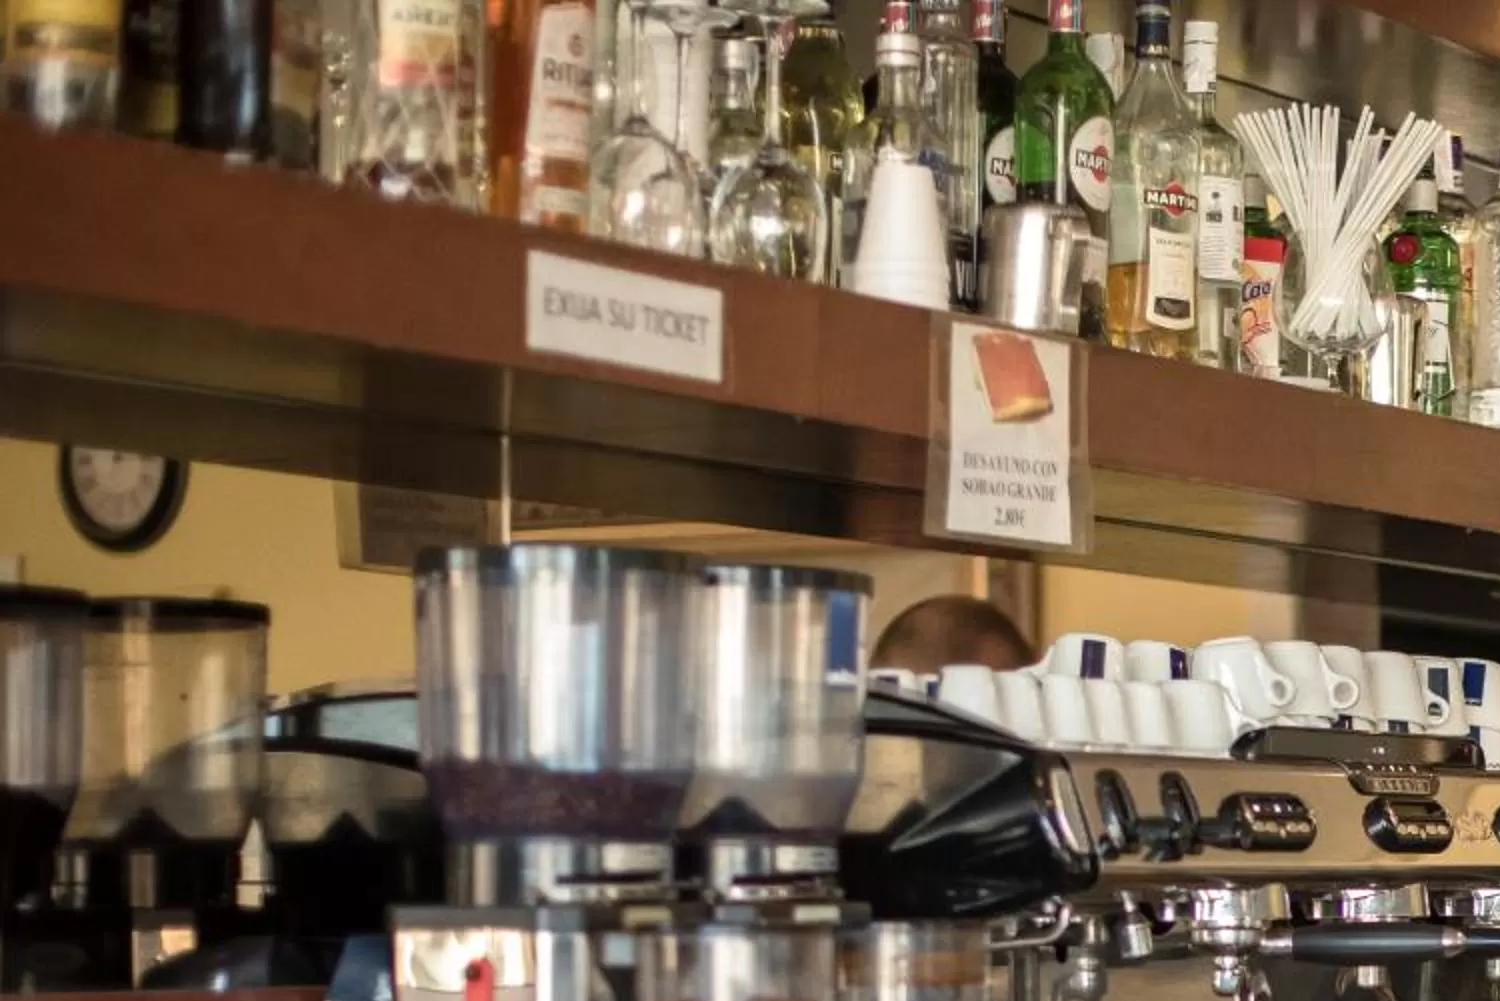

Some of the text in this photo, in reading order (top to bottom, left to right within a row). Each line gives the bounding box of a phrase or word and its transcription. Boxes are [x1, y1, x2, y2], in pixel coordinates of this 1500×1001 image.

[608, 297, 636, 332] SU
[643, 303, 711, 345] TICKET
[963, 451, 1058, 477] DESAYUNO CON
[961, 477, 1057, 502] SOBAO GRANDE
